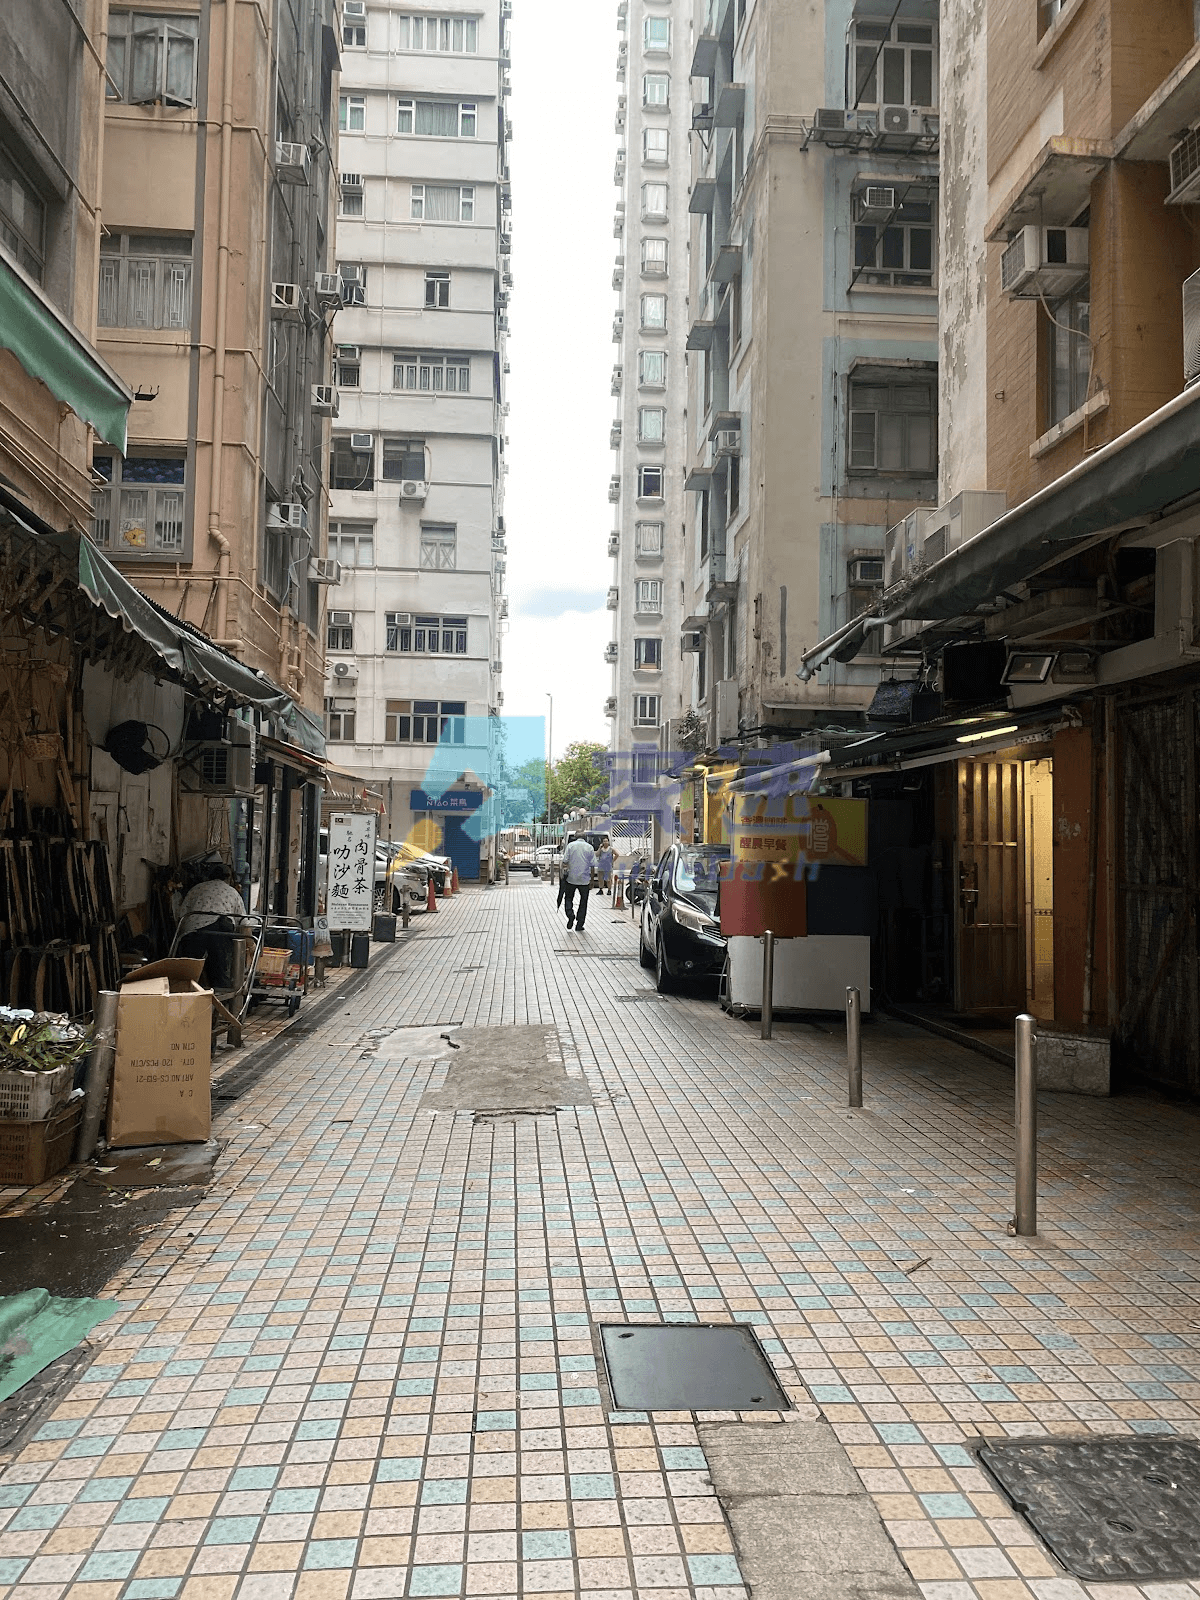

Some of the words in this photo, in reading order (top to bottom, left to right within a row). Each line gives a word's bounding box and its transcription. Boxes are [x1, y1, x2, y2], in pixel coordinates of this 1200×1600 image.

[331, 844, 351, 899] 叻沙麵
[352, 838, 370, 895] 肉骨茶
[130, 1059, 159, 1067] PCS/CTN
[161, 1058, 173, 1067] 120
